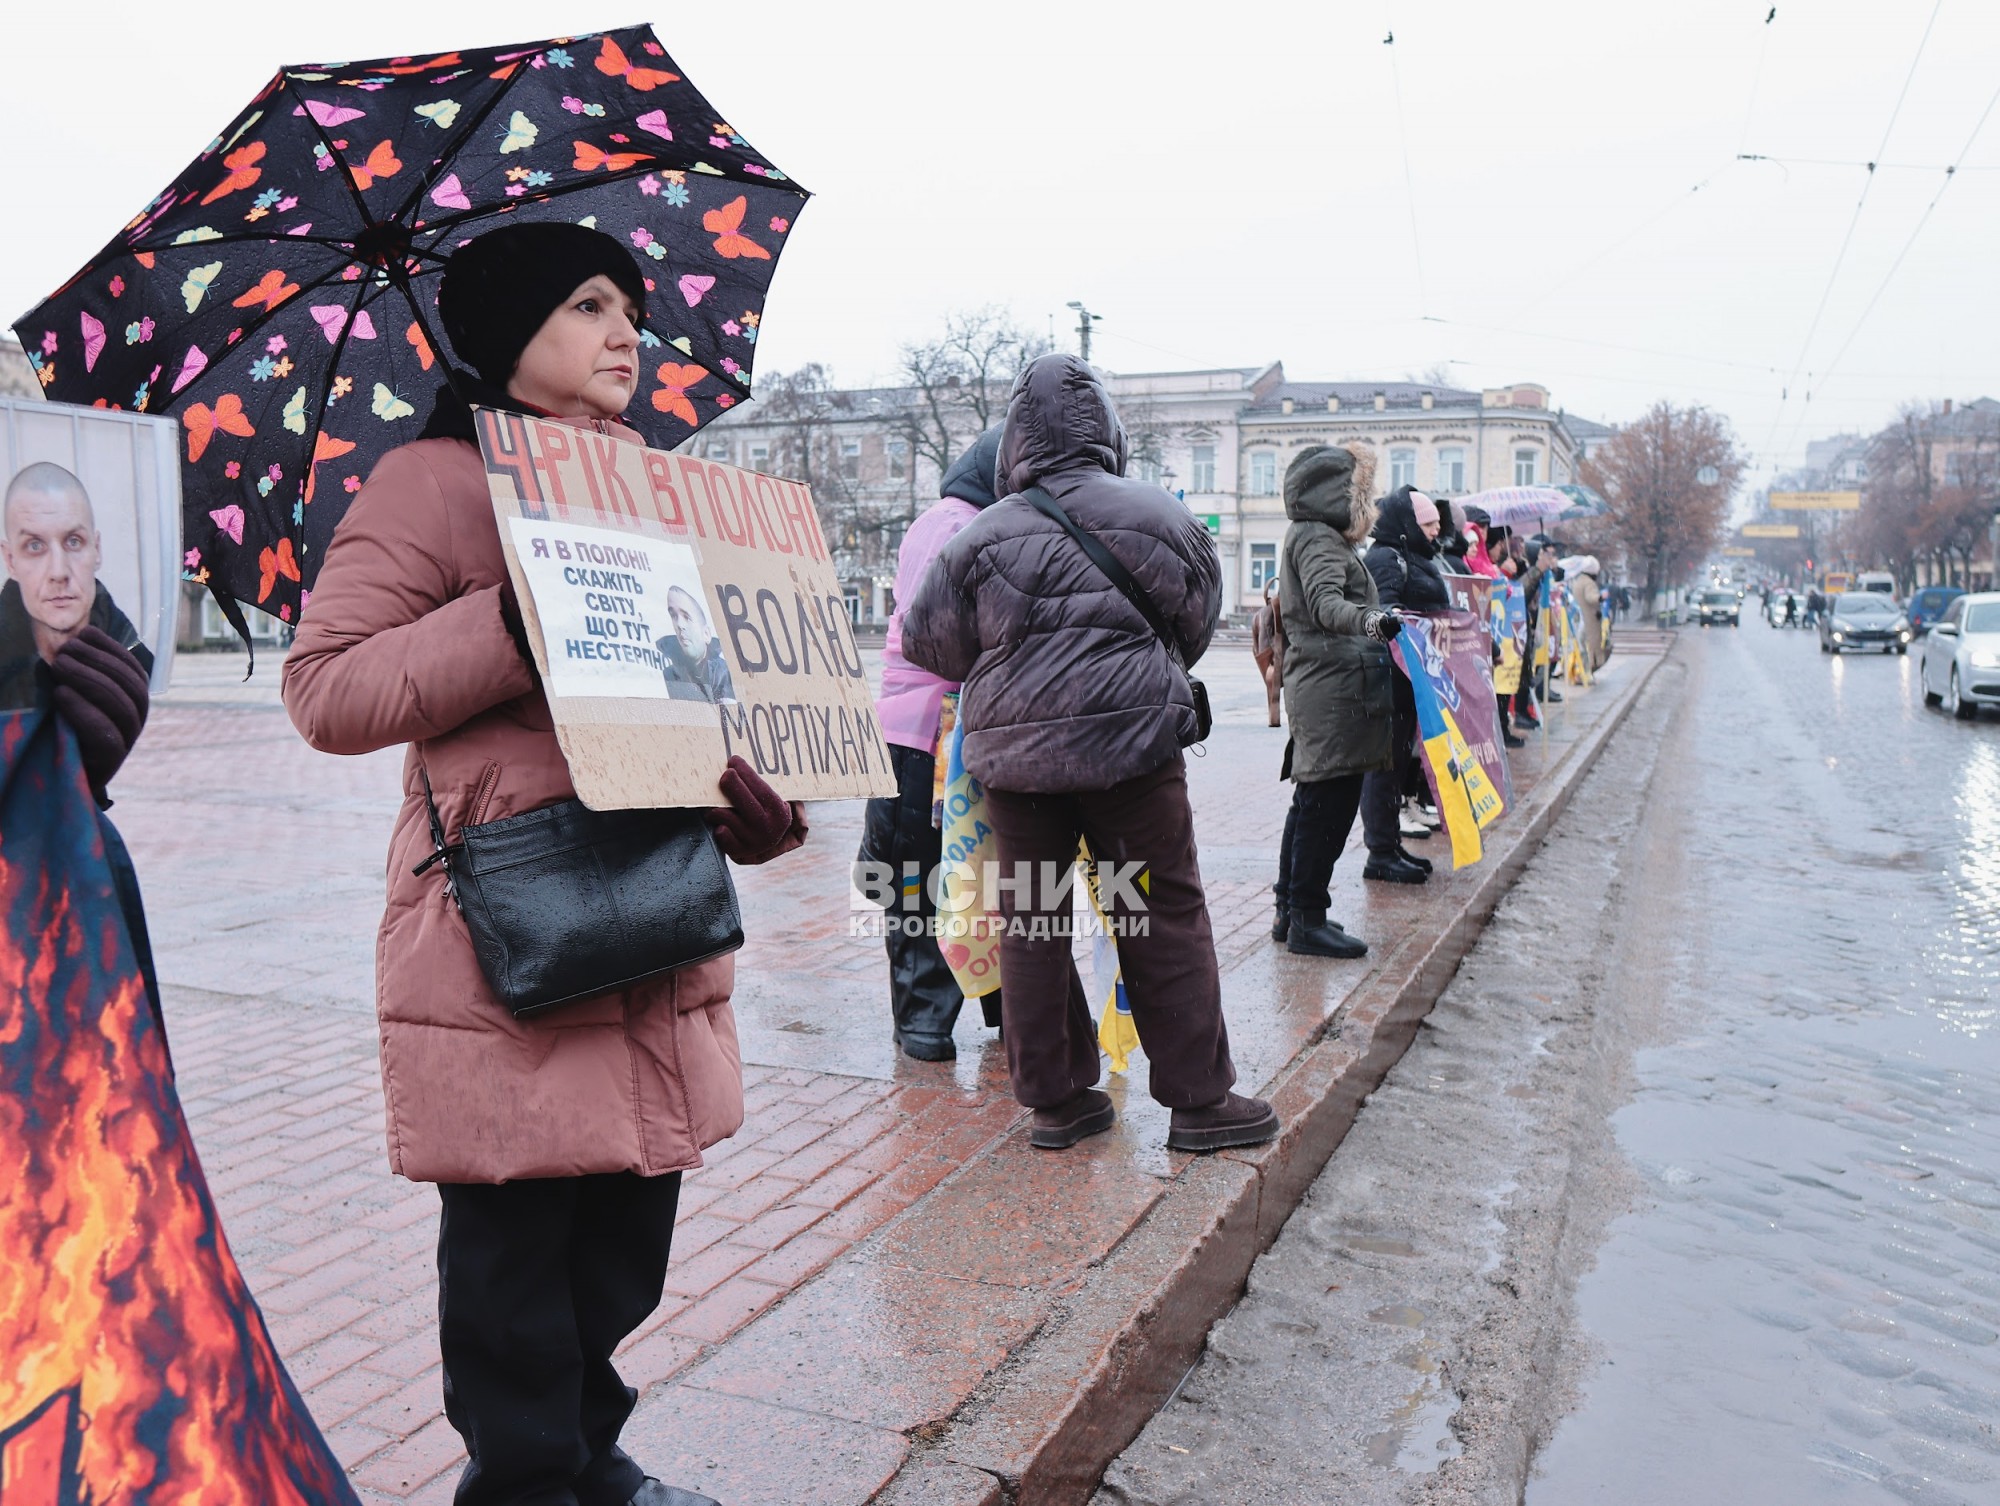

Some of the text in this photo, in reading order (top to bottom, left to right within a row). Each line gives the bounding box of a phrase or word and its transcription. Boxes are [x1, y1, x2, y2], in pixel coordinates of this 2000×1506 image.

[640, 449, 688, 536] В
[677, 456, 827, 562] ПОЛОНІ
[531, 538, 653, 572] Я В ПОЛОНІ!
[563, 566, 644, 595] СКАЖІТЬ
[584, 592, 644, 621] СВІТУ,
[584, 615, 652, 644] ЩО ТУТ
[715, 583, 863, 679] ВОЛЮ
[718, 701, 888, 777] МОРПІХАМ
